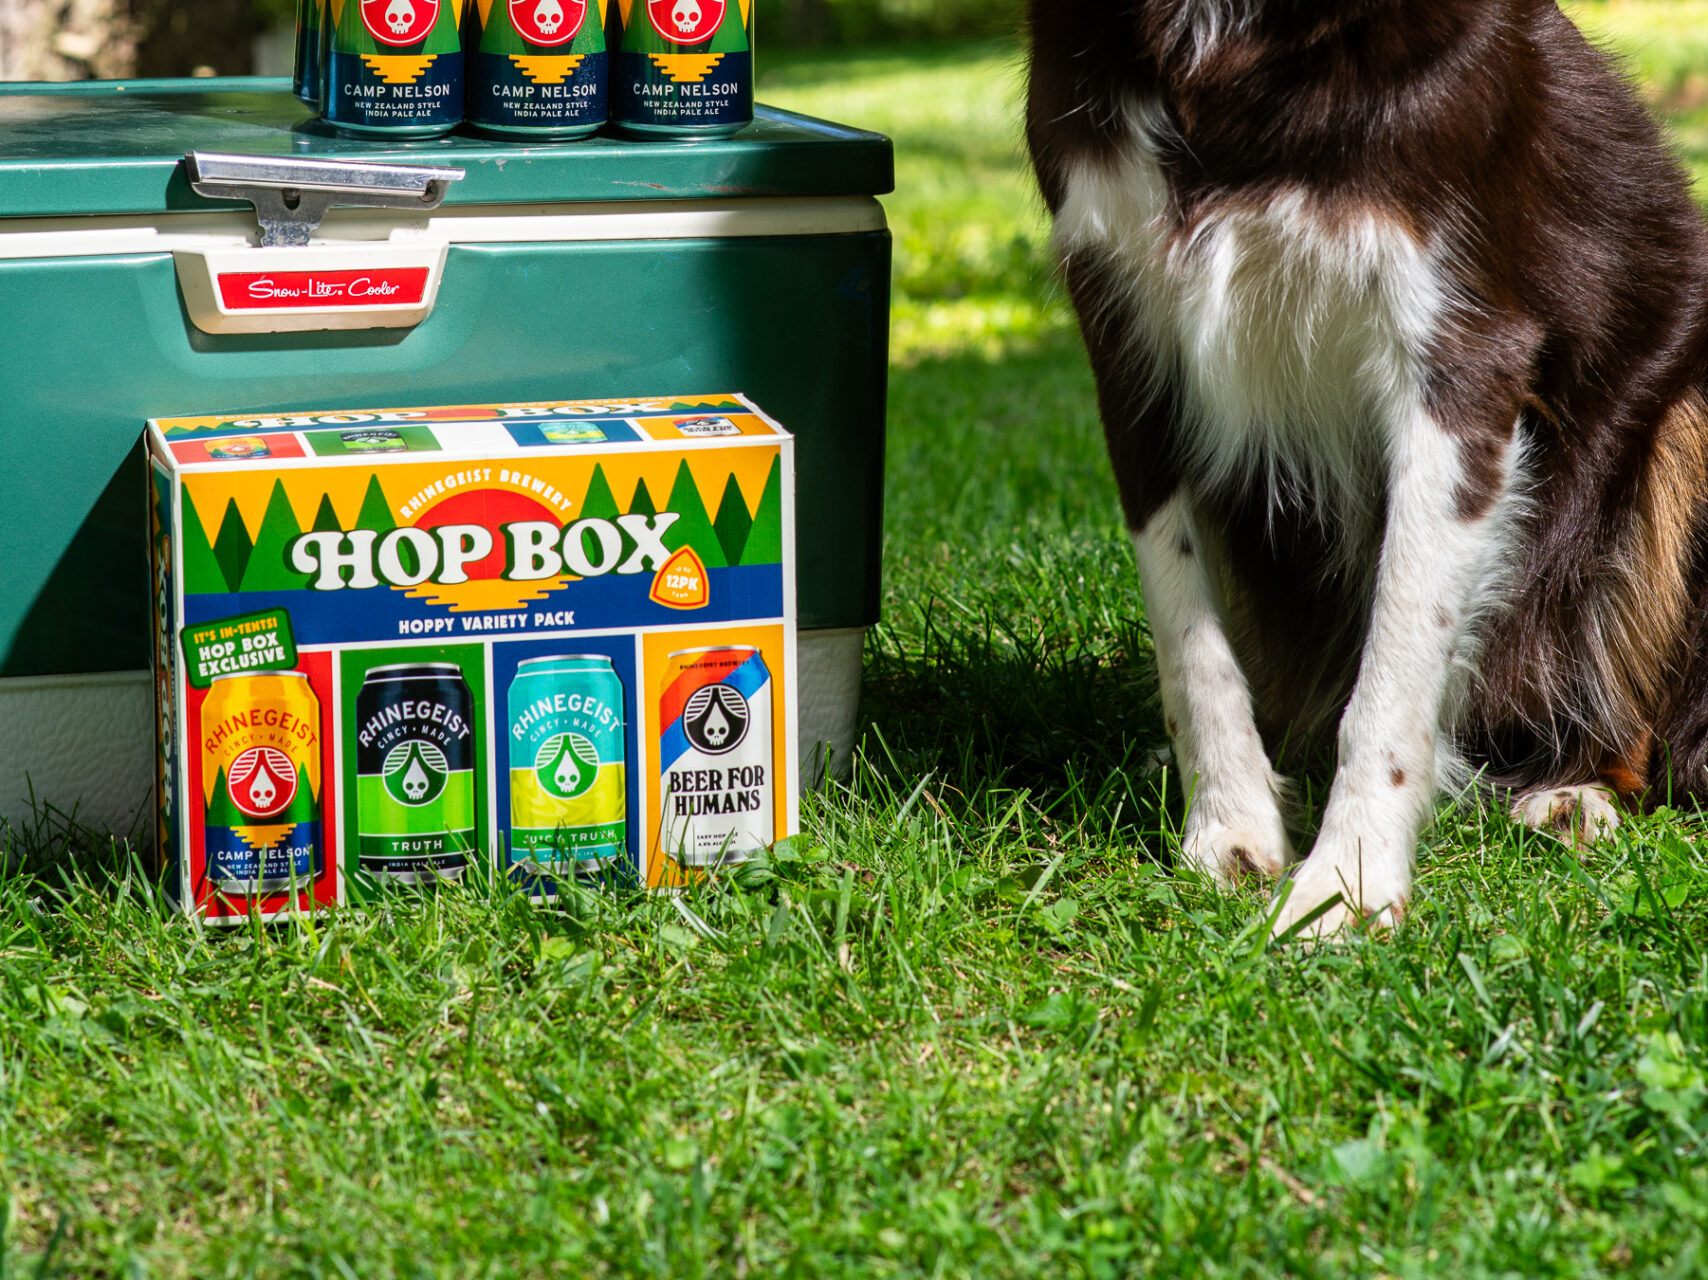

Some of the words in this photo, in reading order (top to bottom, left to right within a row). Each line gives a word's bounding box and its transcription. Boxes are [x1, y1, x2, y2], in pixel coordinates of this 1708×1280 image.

[344, 83, 386, 98] CAMP
[392, 83, 450, 98] NELSON
[492, 84, 535, 98] CAMP
[541, 83, 597, 98] NELSON
[633, 83, 674, 96] CAMP
[680, 82, 738, 96] NELSON
[354, 101, 372, 109] NEW
[374, 102, 415, 110] ZEALAND
[417, 101, 441, 109] STYLE
[365, 109, 389, 117] INDIA
[391, 110, 414, 118] PALE
[415, 109, 432, 117] ALE
[503, 101, 521, 109] NEW
[523, 102, 563, 110] ZEALAND
[565, 101, 588, 109] STYLE
[540, 110, 562, 118] PALE
[564, 109, 580, 117] ALE
[653, 108, 677, 116] INDIA
[680, 108, 702, 116] PALE
[663, 100, 703, 108] ZEALAND
[705, 99, 729, 107] STYLE
[347, 277, 400, 297] Cooler
[232, 410, 428, 429] HOP
[503, 401, 672, 417] BOX
[399, 468, 491, 519] RHINEGEIST
[499, 469, 572, 511] BREWERY
[289, 524, 494, 592] HOP
[503, 511, 682, 582] BOX
[666, 574, 699, 591] 12PK
[193, 630, 217, 644] IT'S
[220, 617, 278, 639] IN-TENTS!
[398, 618, 454, 634] HOPPY
[461, 614, 528, 631] VARIETY
[534, 611, 575, 627] PACK
[198, 641, 236, 661] HOP
[241, 632, 279, 652] BOX
[198, 646, 286, 677] EXCLUSIVE
[359, 700, 470, 748] RHINEGEIST
[512, 693, 620, 741] RHINEGEIST
[204, 708, 317, 755] RHINEGEIST
[377, 725, 407, 749] CINCY
[421, 725, 451, 746] MADE
[670, 769, 723, 793] BEER
[727, 765, 765, 790] FOR
[674, 789, 761, 816] HUMANS
[391, 839, 442, 851] TRUTH
[570, 829, 615, 842] TRUTH
[217, 850, 253, 861] CAMP
